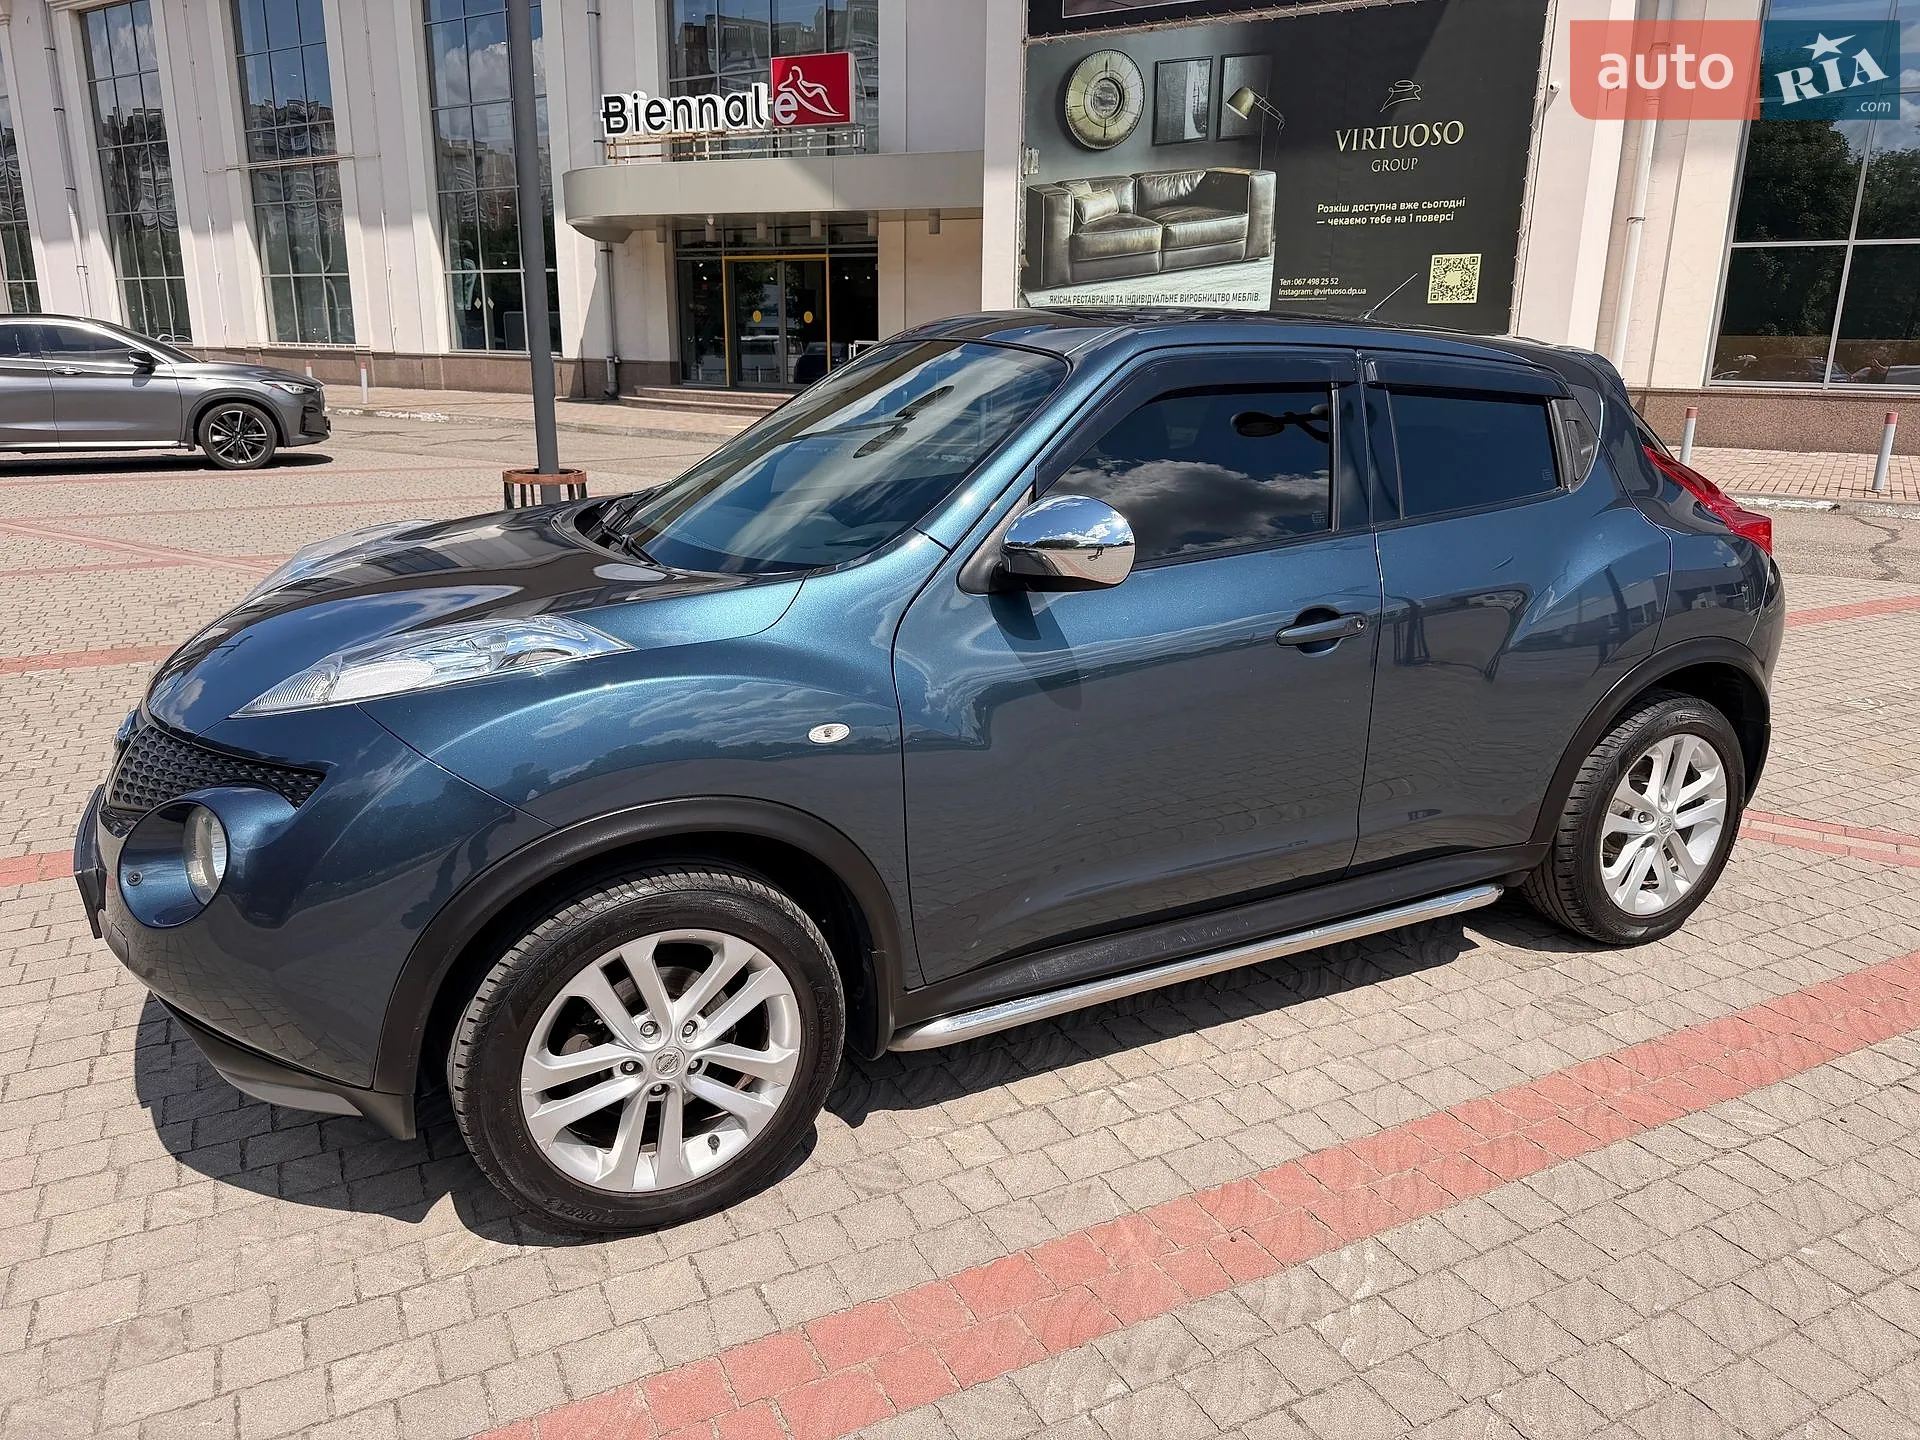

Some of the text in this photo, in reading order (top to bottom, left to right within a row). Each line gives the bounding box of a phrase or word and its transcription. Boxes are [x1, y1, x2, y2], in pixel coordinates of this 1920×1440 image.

[602, 82, 798, 137] Biennale
[1335, 120, 1465, 152] VIRTUOSO
[1371, 157, 1418, 173] GROUP
[1317, 196, 1467, 214] Розкіш доступна вже сьогодні
[1327, 216, 1368, 227] чекаємо
[1369, 213, 1392, 225] тебе
[1394, 214, 1407, 224] на
[1408, 212, 1413, 223] 1
[1415, 210, 1455, 225] поверсі
[1306, 277, 1320, 286] 498
[1320, 277, 1330, 285] 25
[1330, 277, 1340, 285] 52
[1049, 294, 1072, 304] ЯКІСНА
[1072, 294, 1115, 305] РЕСТАВРАЦІЯ
[1115, 294, 1124, 304] ТА
[1179, 292, 1231, 304] ВИРОБНИЦТВО
[1278, 287, 1313, 297] Instagram:
